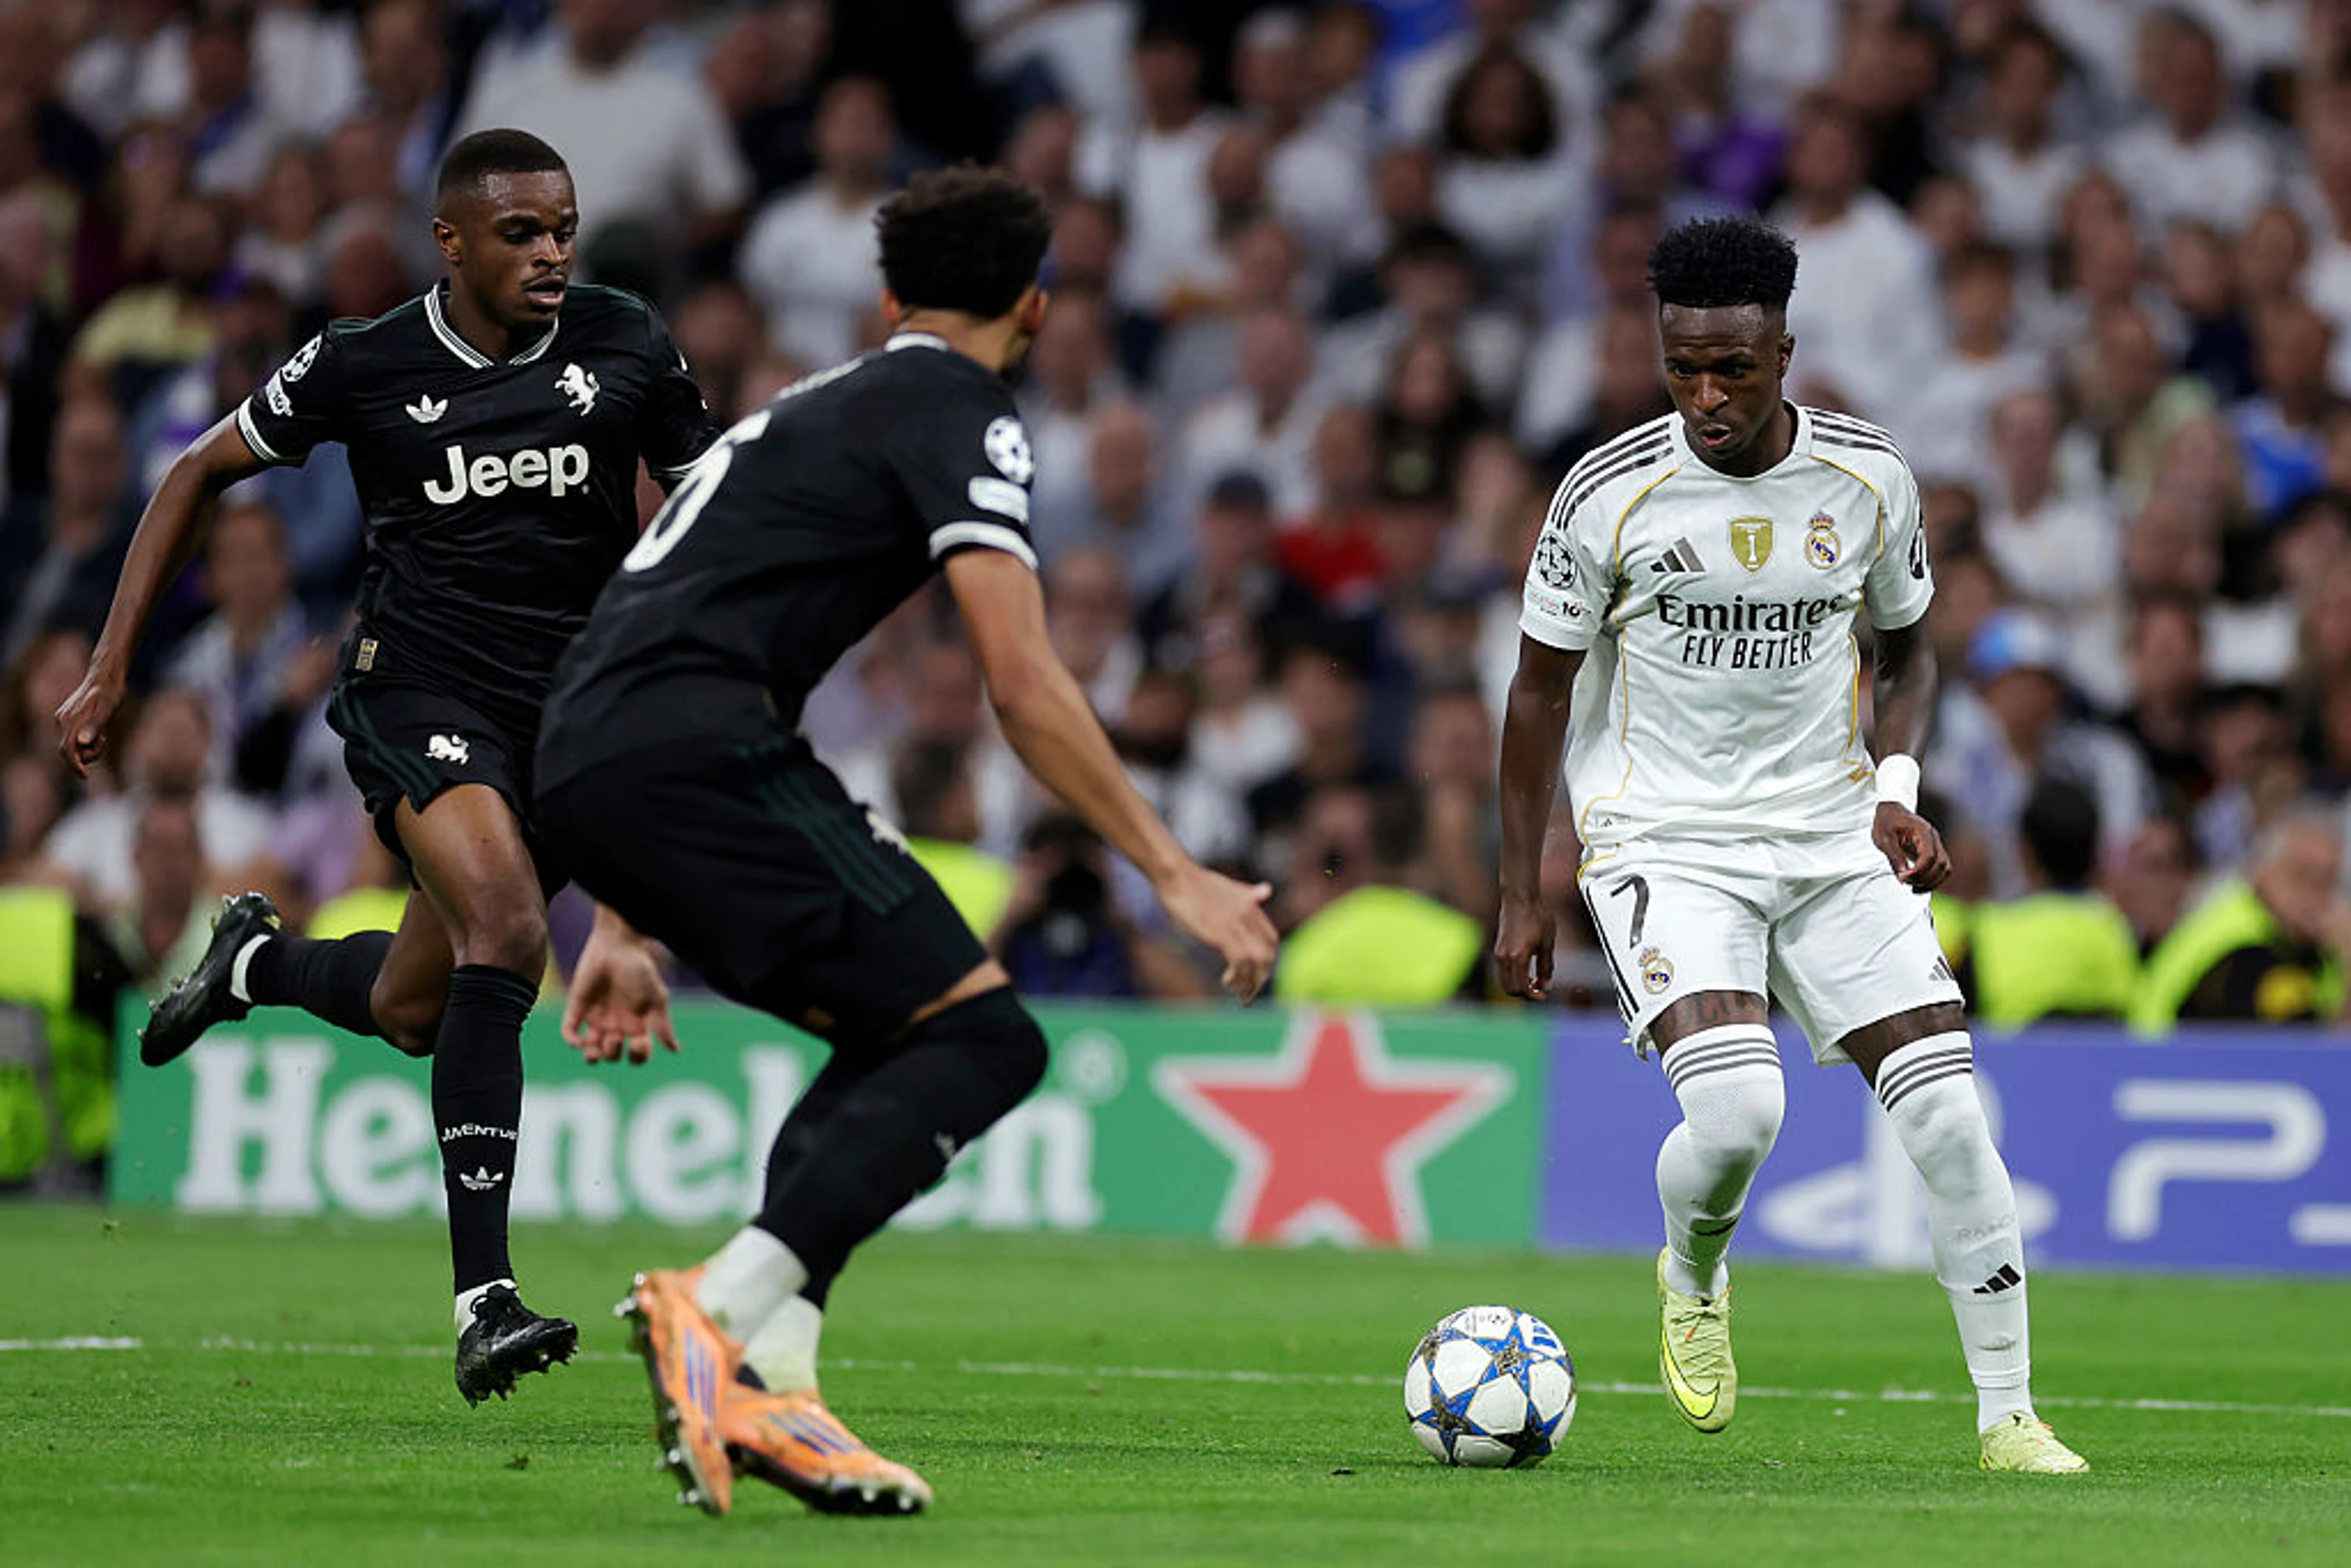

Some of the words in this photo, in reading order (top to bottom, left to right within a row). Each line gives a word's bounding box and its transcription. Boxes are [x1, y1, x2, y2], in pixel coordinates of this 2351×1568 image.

[422, 443, 589, 505] Jeep
[1682, 635, 1725, 667] FLY
[1731, 631, 1813, 669] BETTER
[1610, 872, 1649, 949] 7
